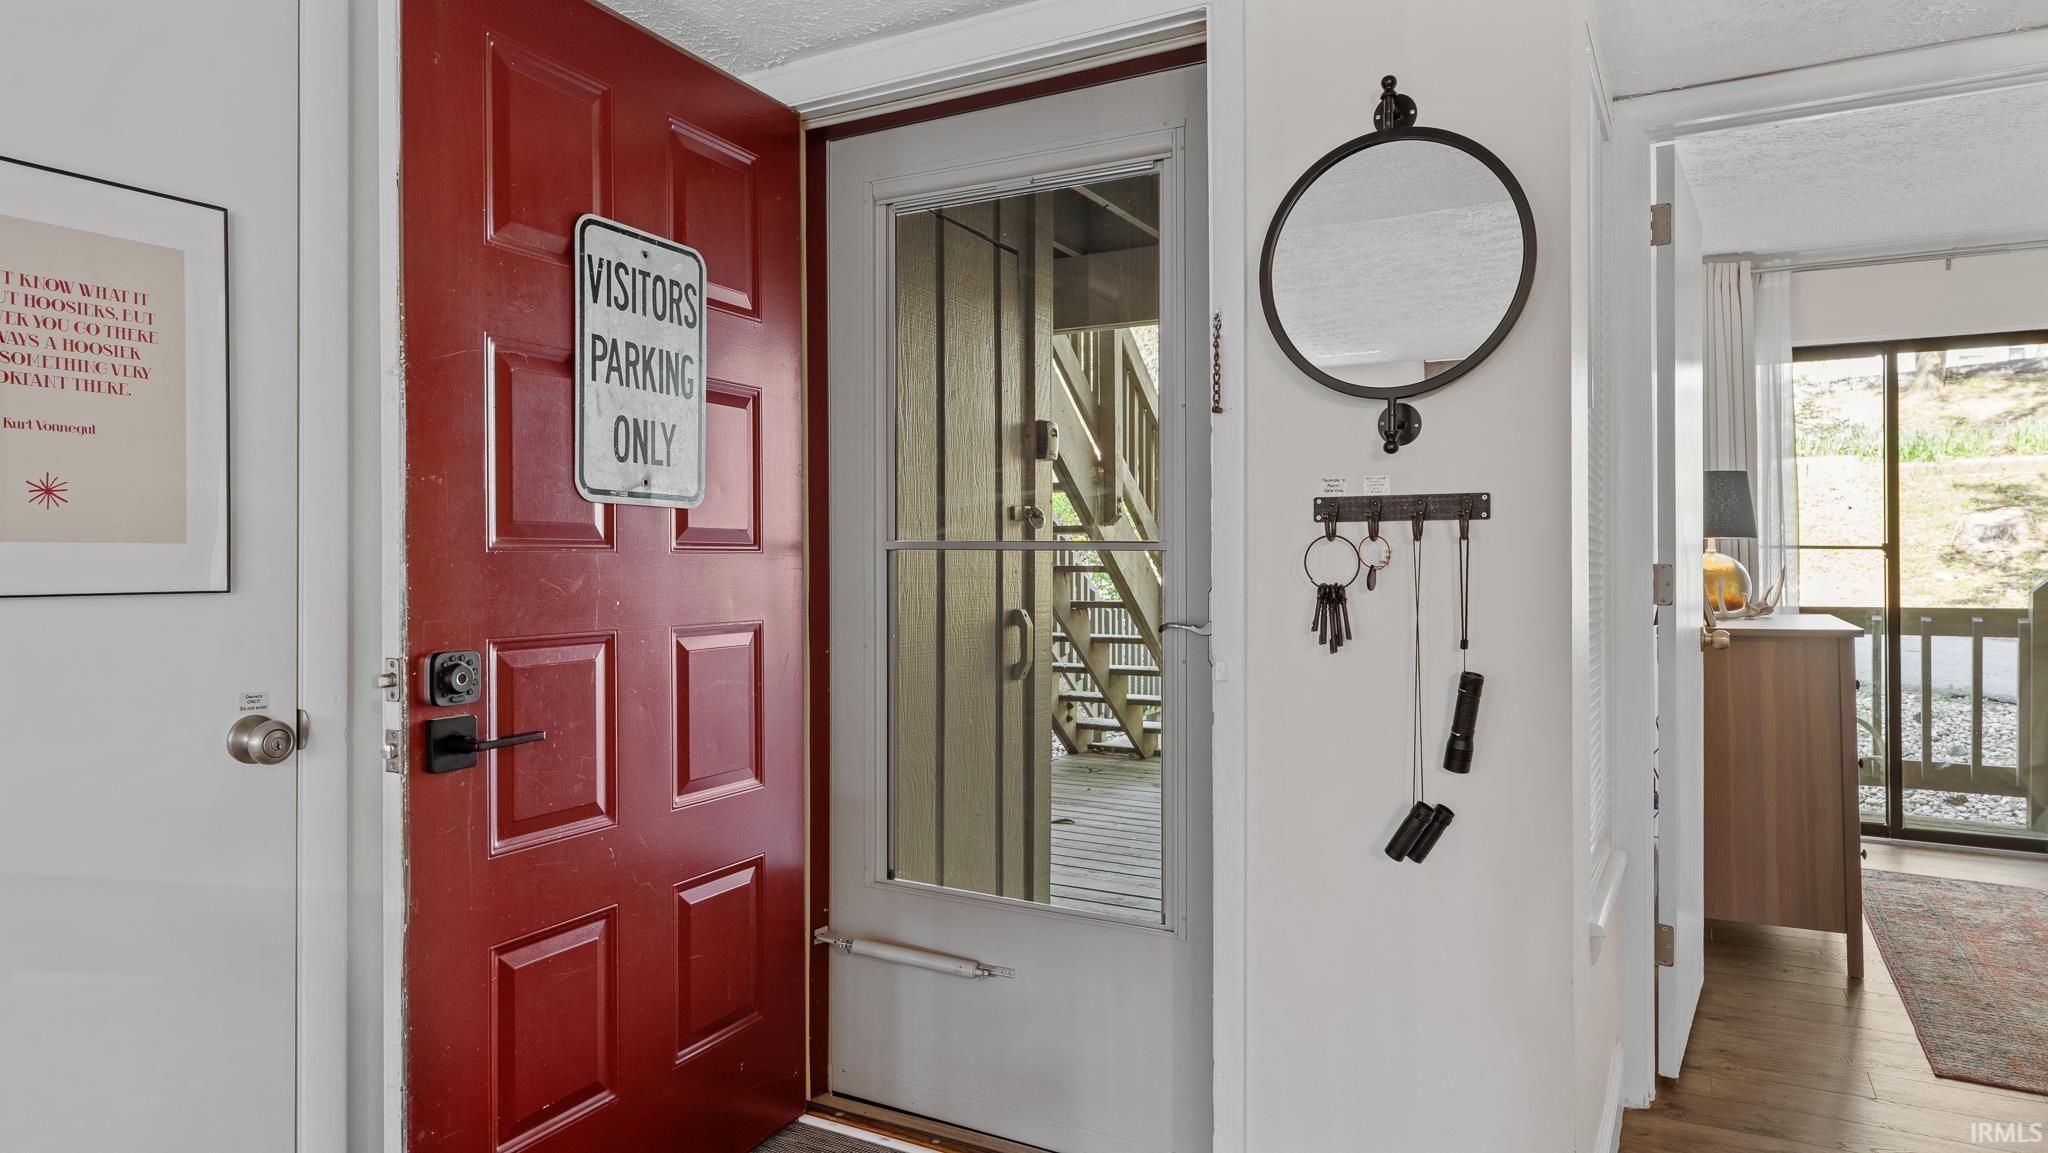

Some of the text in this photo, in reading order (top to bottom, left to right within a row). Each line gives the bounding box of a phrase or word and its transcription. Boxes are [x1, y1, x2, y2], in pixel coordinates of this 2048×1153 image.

[18, 273, 75, 294] KNOW
[78, 282, 129, 303] WHAT
[134, 291, 149, 306] IT
[586, 254, 697, 329] VISITORS
[0, 310, 158, 344] ER YOU GO THERE
[122, 308, 156, 325] BUT
[45, 336, 57, 350] A
[63, 338, 141, 360] HOOSIER
[0, 350, 152, 379] SOMETHING VERY
[591, 333, 694, 400] PARKING
[71, 377, 131, 396] THERE.
[3, 417, 96, 436] Kurt Vonnegut
[613, 414, 677, 467] ONLY
